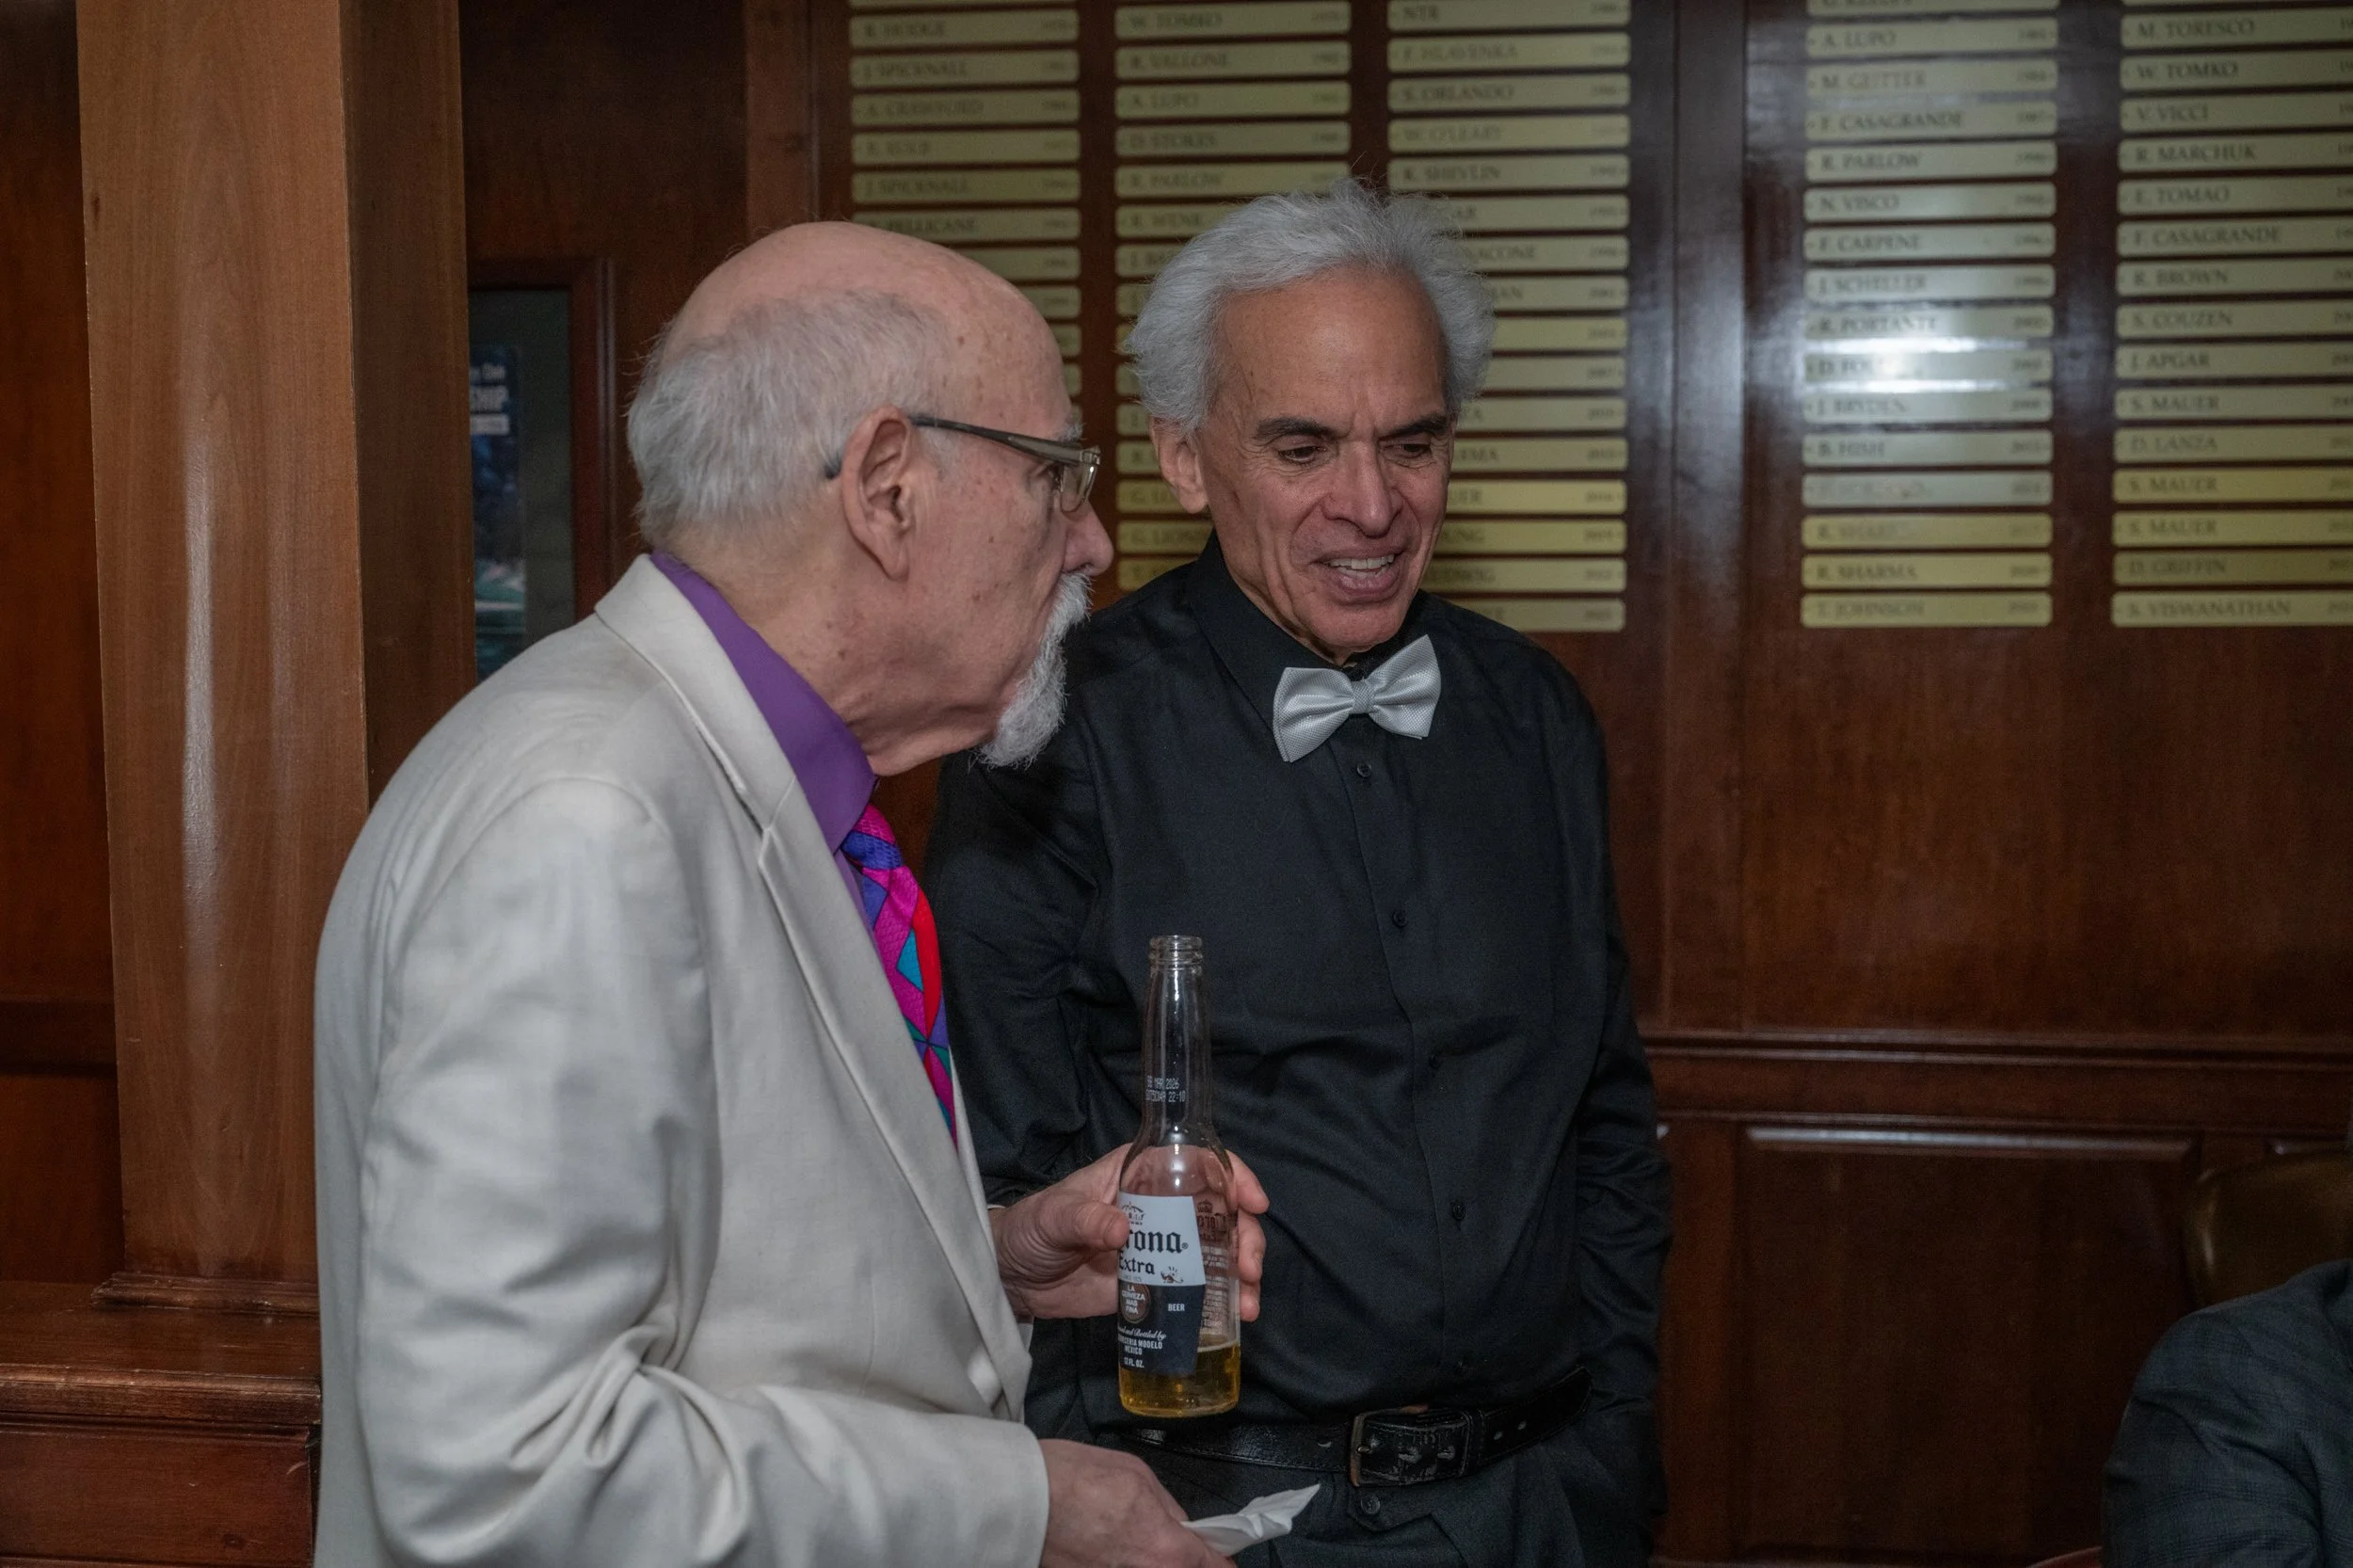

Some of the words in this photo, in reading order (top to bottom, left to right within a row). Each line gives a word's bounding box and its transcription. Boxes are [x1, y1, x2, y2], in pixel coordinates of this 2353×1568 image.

[2138, 23, 2155, 38] M.
[2167, 19, 2254, 38] TORESCO
[1823, 34, 1837, 47] A.
[1845, 30, 1897, 48] LUPO
[2137, 64, 2159, 78] W.
[2167, 61, 2239, 78] TOMKO
[1821, 74, 1840, 88] M.
[1421, 85, 1514, 101] ORLANDO
[2158, 103, 2209, 120] VICCI
[1839, 111, 1962, 132] CASAGRANDE
[1821, 155, 1837, 169] R.
[1842, 152, 1920, 169] PARLOW
[2137, 148, 2151, 162] R.
[2157, 143, 2257, 163] MARCHUK
[1819, 196, 1836, 210] N.
[1843, 193, 1898, 210] VISCO
[2156, 186, 2231, 203] TOMAO
[1837, 233, 1920, 251] CARPENE
[2153, 226, 2281, 246] CASAGRANDE
[2135, 272, 2151, 287] R.
[2156, 269, 2230, 287] BROWN
[2153, 311, 2233, 328] COUZEN
[2132, 352, 2141, 370] J.
[2146, 351, 2210, 369] APGAR
[2132, 396, 2146, 410] S.
[2151, 394, 2219, 411] MAUER
[2131, 437, 2149, 453] D.
[2154, 435, 2218, 452] LANZA
[2150, 476, 2217, 493] MAUER
[2150, 519, 2217, 536] MAUER
[1838, 562, 1918, 579] SHARMA
[2152, 559, 2227, 576] GRIFFIN
[2149, 599, 2291, 617] VISWANATHAN
[1134, 1328, 1158, 1338] Bottled
[1157, 1330, 1167, 1341] by
[1138, 1339, 1162, 1350] MODELO
